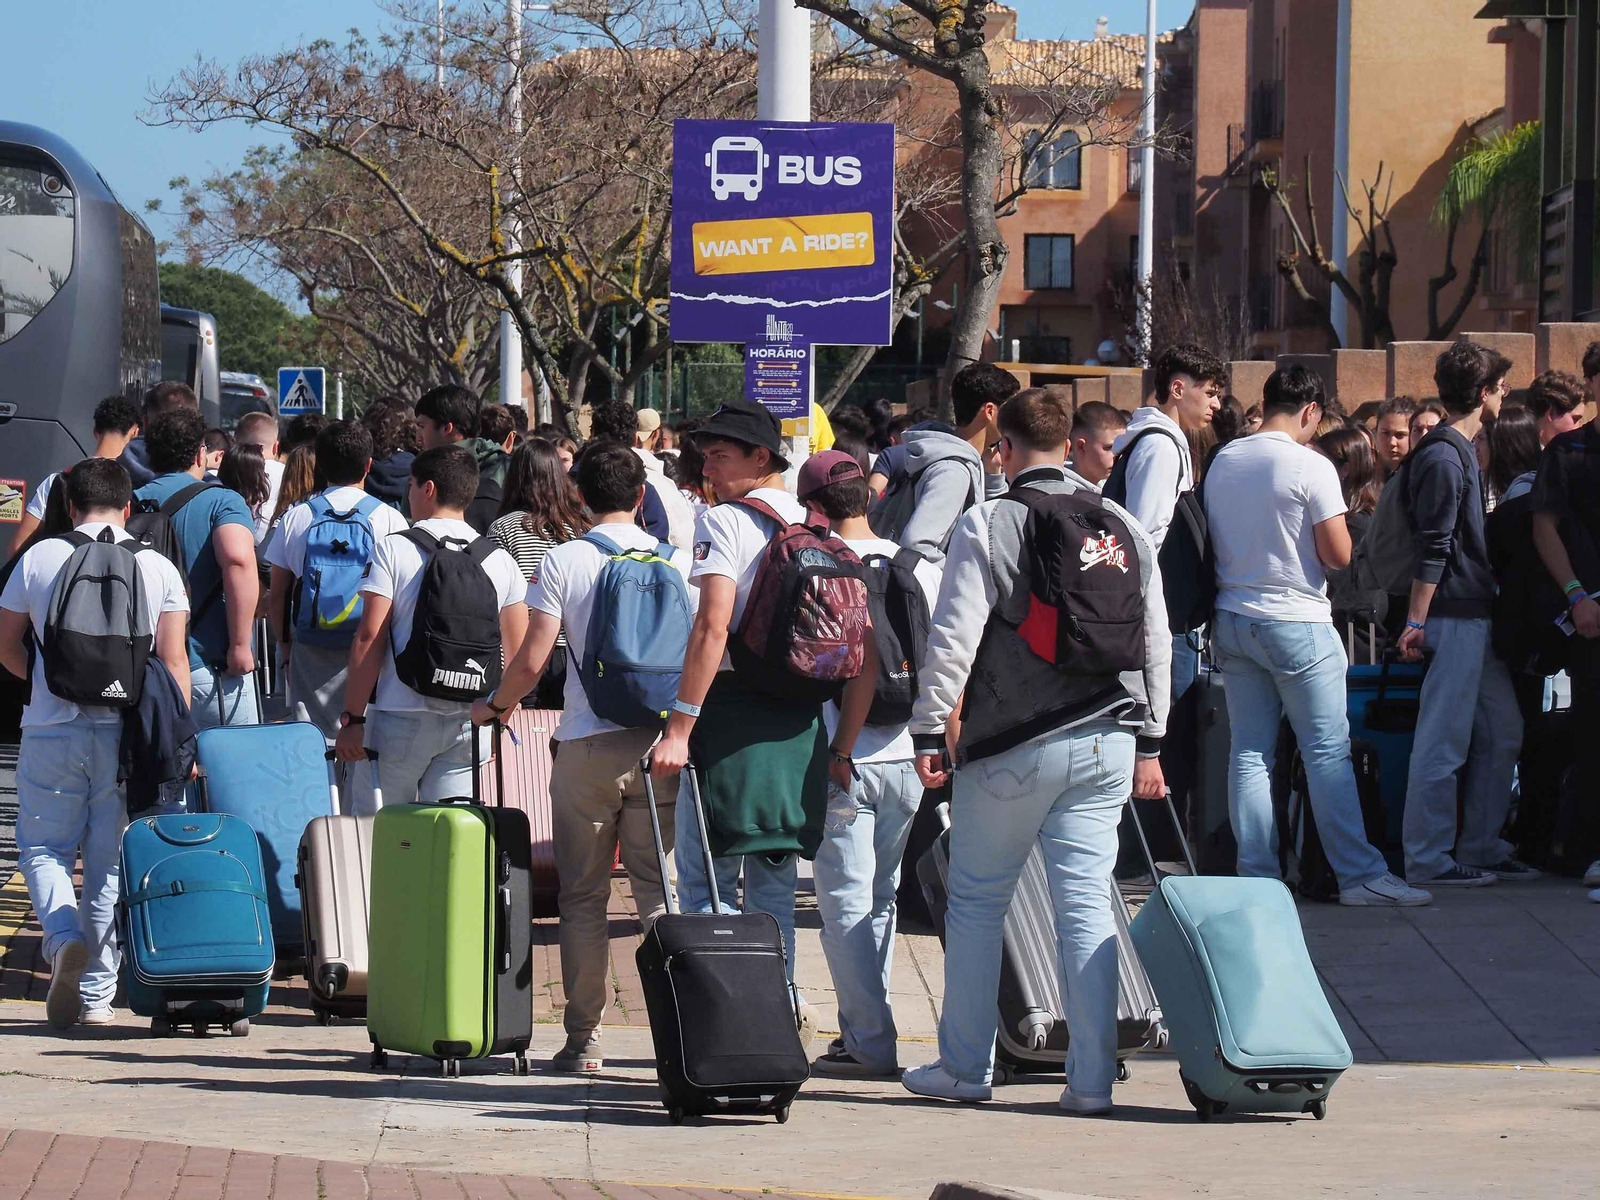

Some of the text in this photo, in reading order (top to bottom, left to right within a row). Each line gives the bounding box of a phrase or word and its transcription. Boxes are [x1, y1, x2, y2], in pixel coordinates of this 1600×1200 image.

[779, 155, 862, 186] BUS
[699, 232, 868, 258] WANT A RIDE?
[750, 347, 807, 359] HORÁRIO
[432, 668, 481, 691] PUMA
[101, 690, 127, 698] adidas
